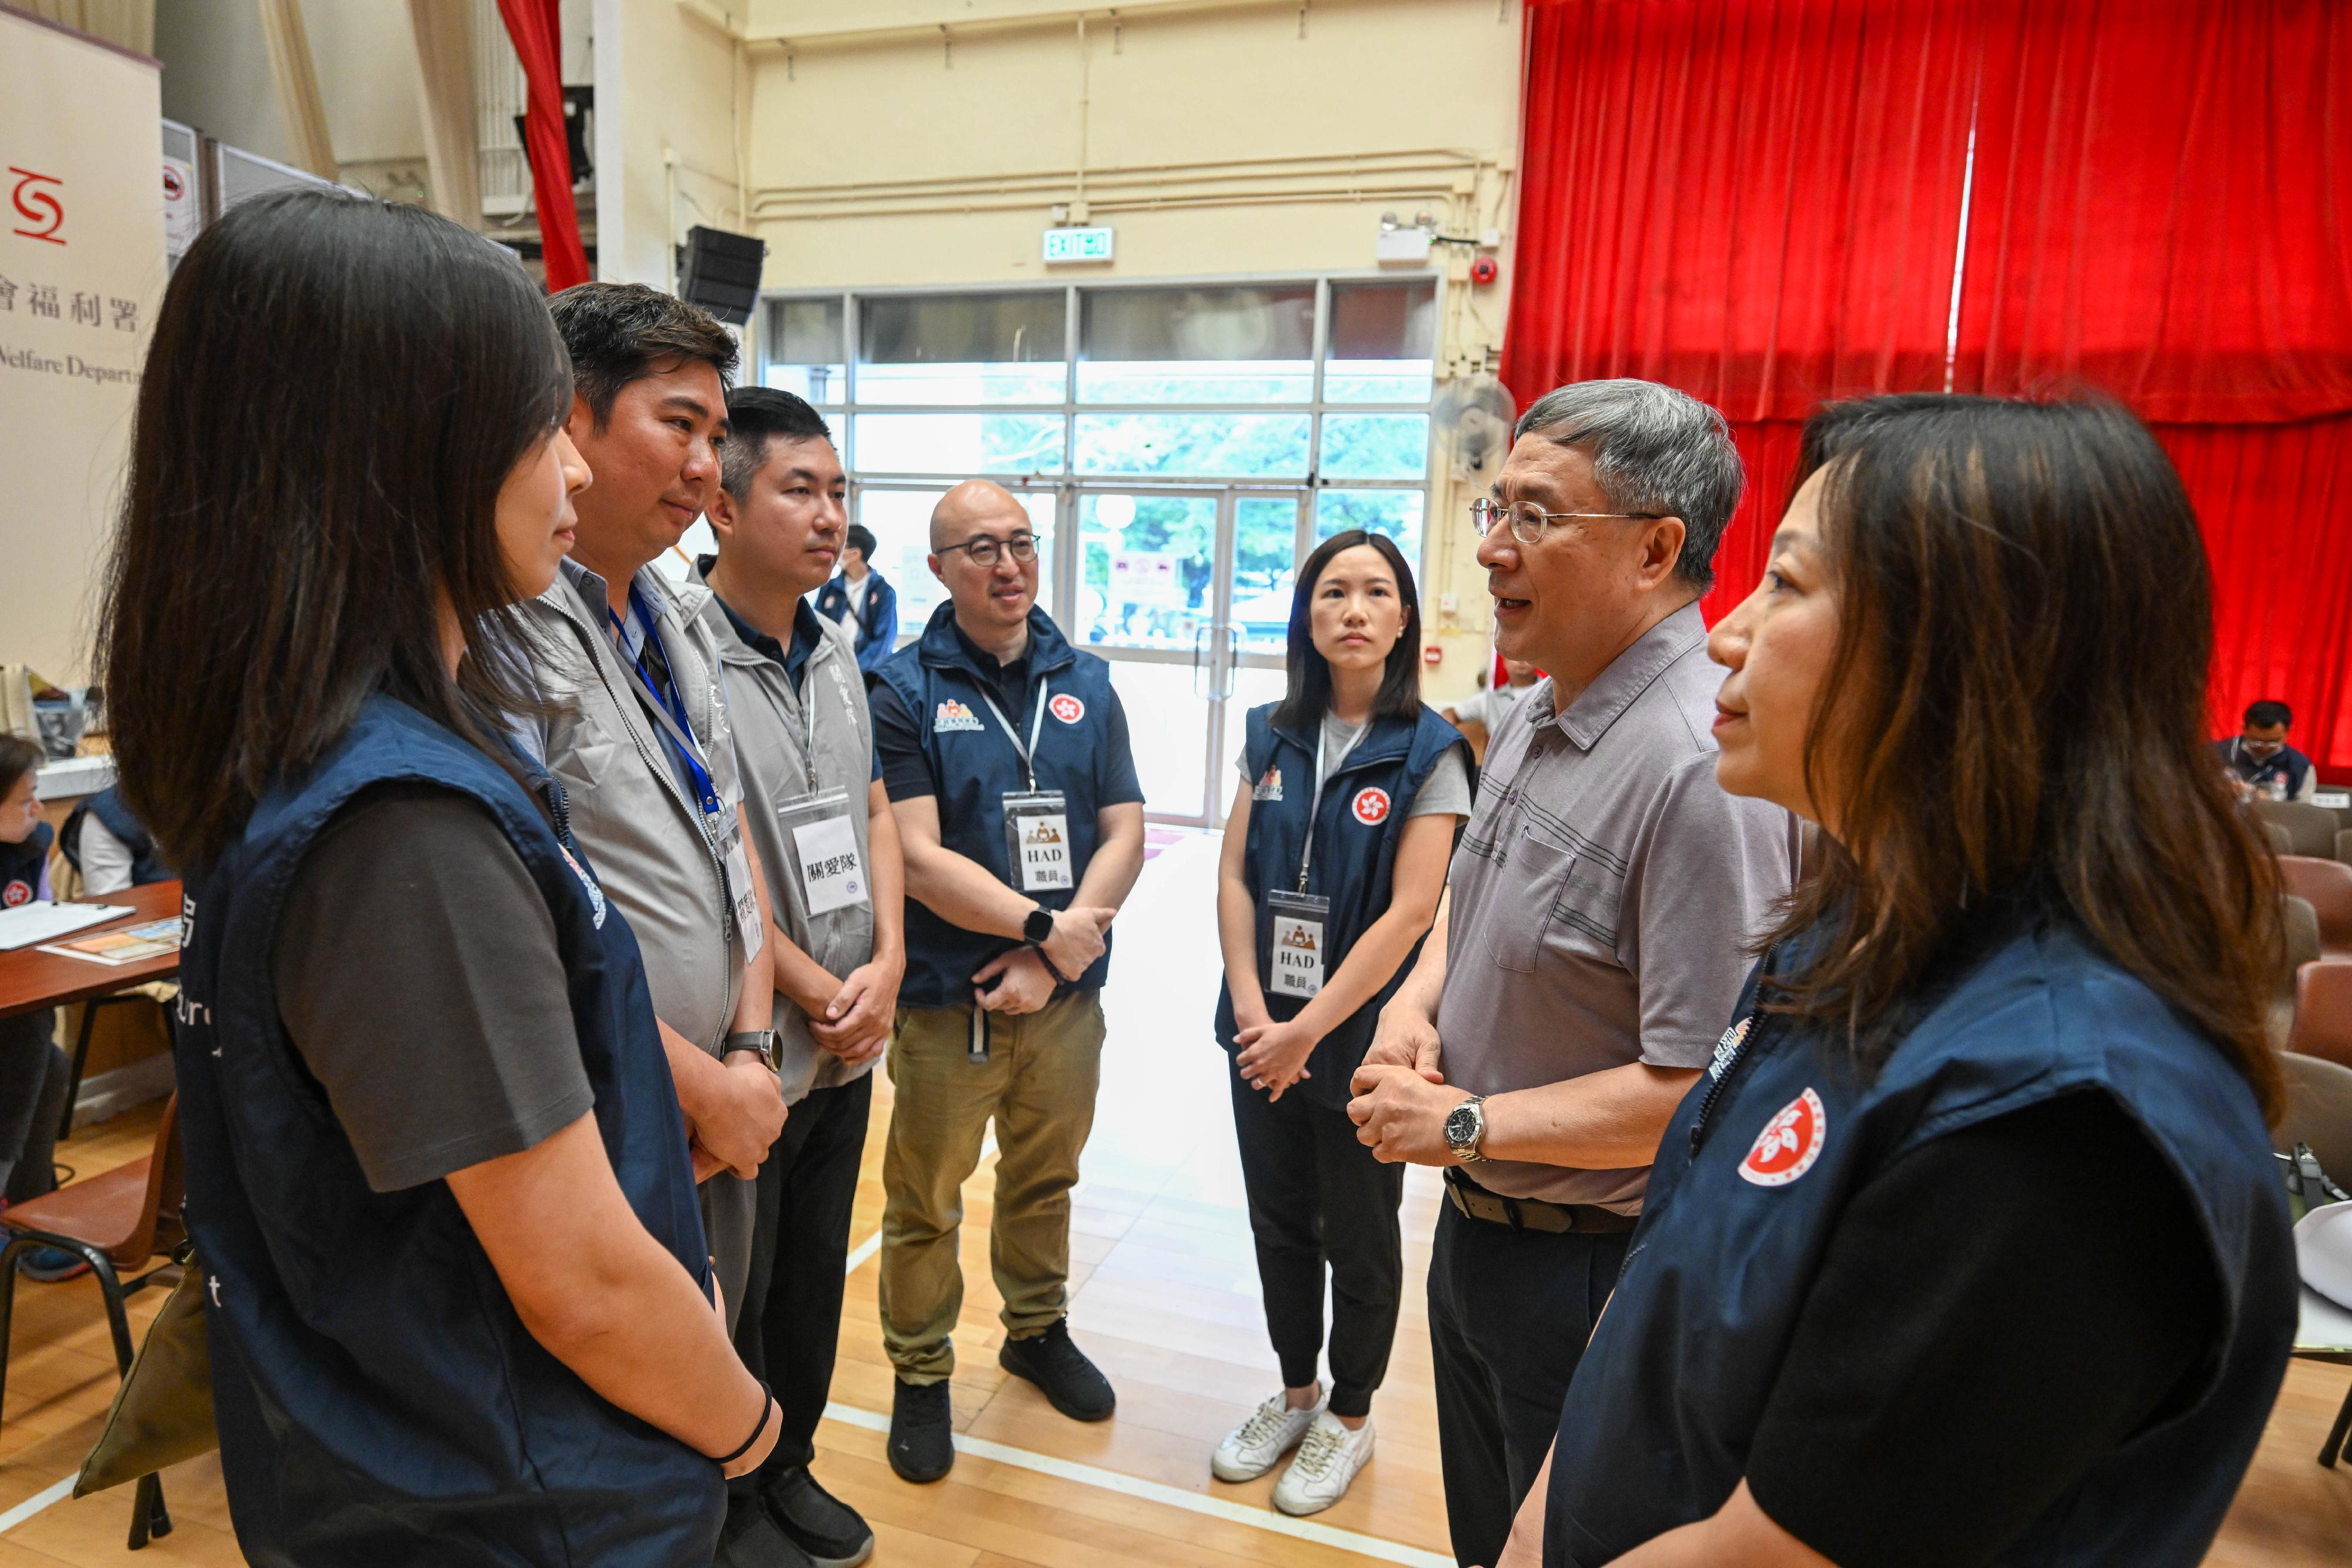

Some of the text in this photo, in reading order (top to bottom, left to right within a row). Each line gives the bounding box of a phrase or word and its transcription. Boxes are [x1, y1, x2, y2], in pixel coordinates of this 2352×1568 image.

[1048, 232, 1106, 256] EXIT 出口
[1028, 849, 1062, 862] HAD
[807, 852, 857, 882] 關愛隊
[1035, 870, 1058, 882] 職員
[1281, 951, 1314, 968] HAD
